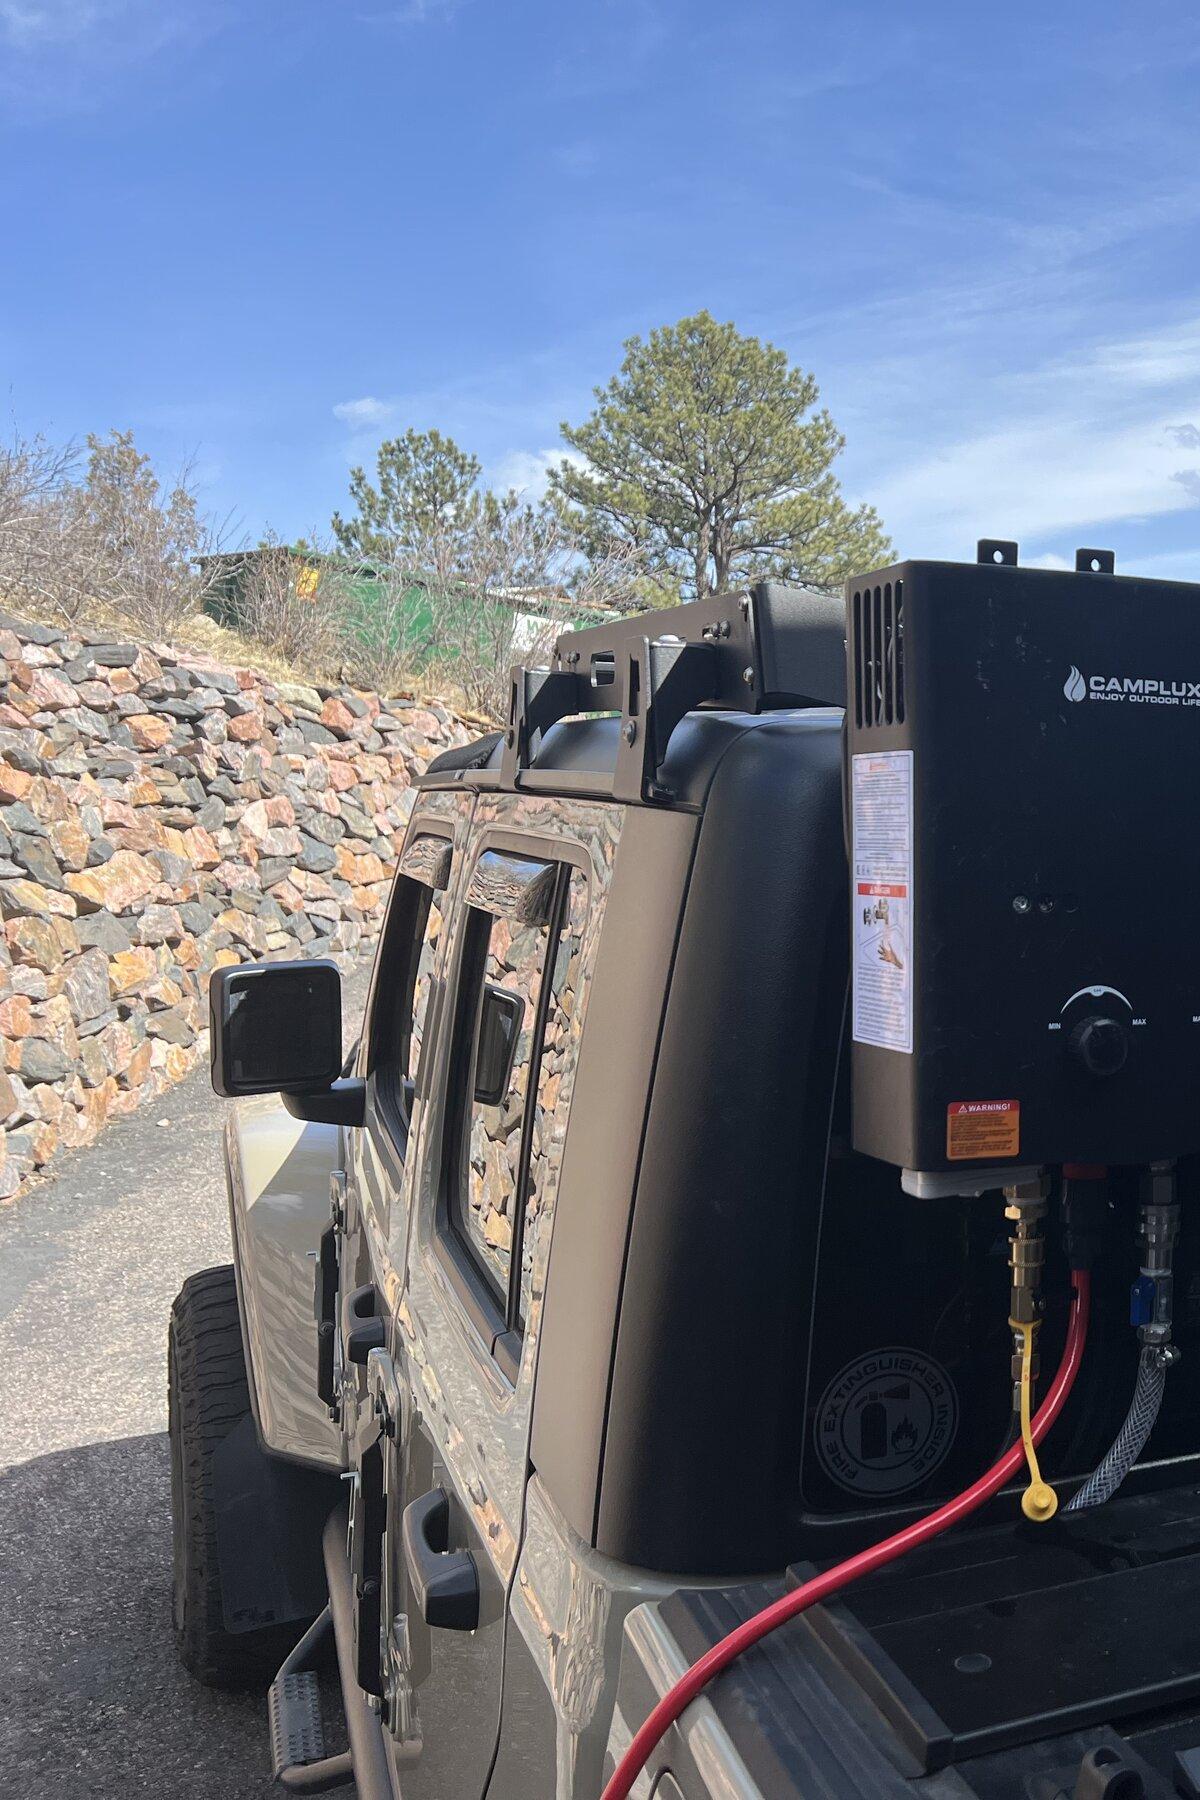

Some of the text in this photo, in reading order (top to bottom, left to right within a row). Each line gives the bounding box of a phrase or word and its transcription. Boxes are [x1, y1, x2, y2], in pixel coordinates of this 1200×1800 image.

[1089, 692, 1126, 702] ENJOY
[1129, 694, 1179, 705] OUTDOOR
[1048, 1022, 1061, 1030] MIN
[968, 1103, 1011, 1112] WARNING!
[823, 1357, 949, 1480] FIRE EXTINGUISHER INSIDE
